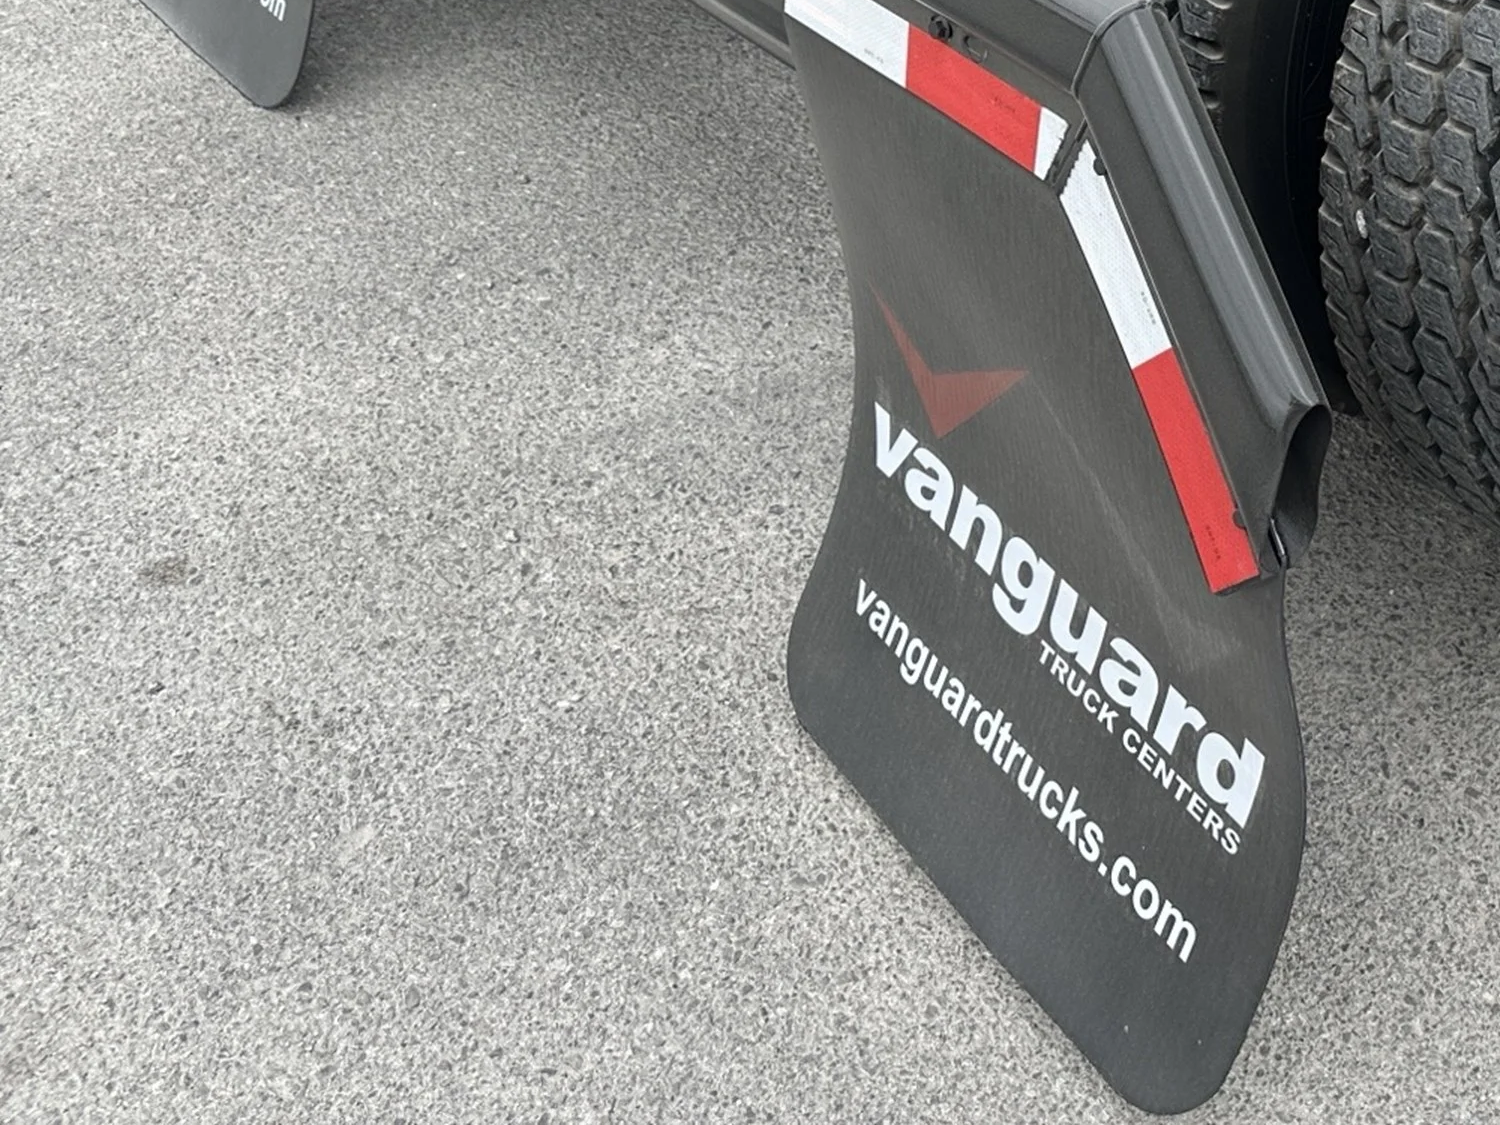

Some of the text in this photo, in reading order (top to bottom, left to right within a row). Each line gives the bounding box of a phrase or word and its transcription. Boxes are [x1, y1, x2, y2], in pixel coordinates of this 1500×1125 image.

[854, 578, 1197, 963] vanguardtrucks.com
[873, 401, 1265, 829] vanguard
[1039, 639, 1241, 856] TRUCK CENTERS
